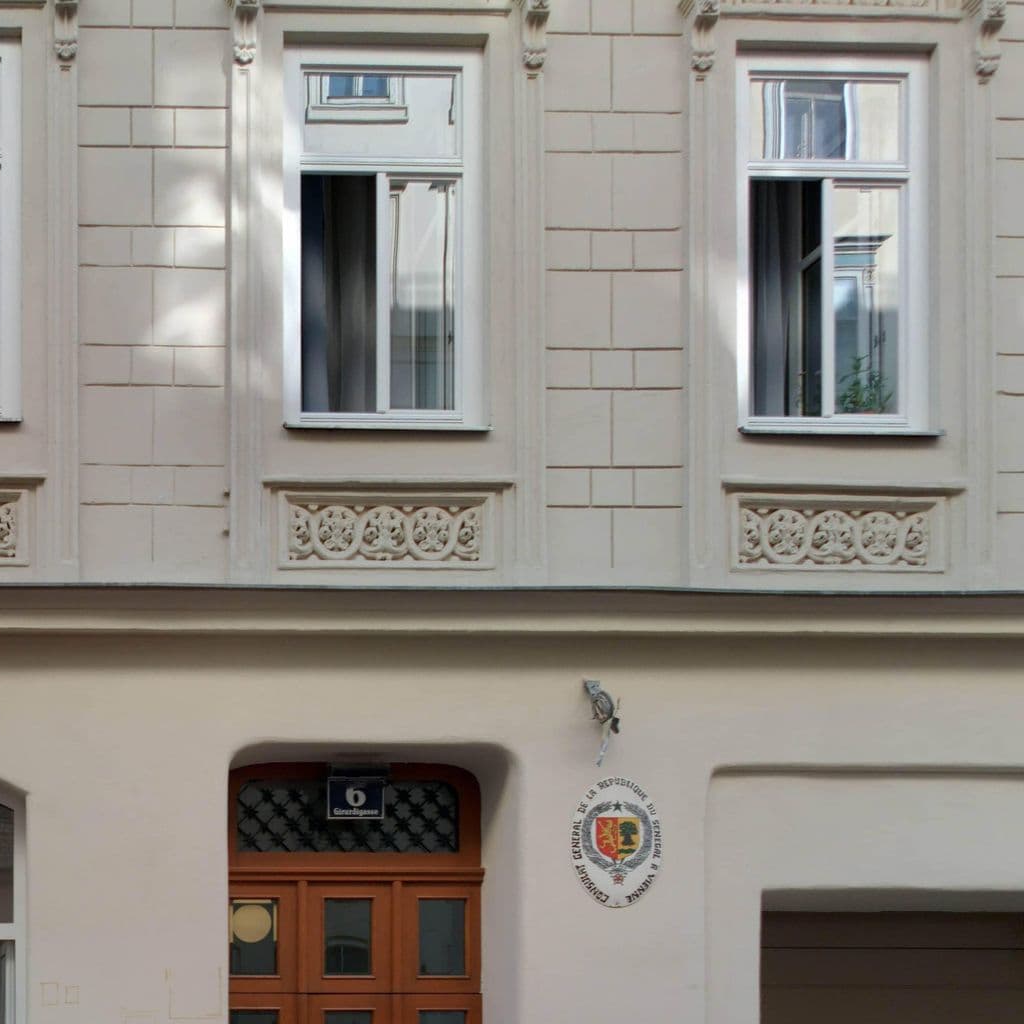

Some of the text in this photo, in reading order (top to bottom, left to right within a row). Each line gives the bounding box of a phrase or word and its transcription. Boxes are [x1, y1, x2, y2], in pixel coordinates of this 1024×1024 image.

[346, 784, 367, 807] 6
[586, 789, 597, 800] LA
[577, 802, 588, 814] DE
[646, 803, 657, 815] DU
[571, 820, 582, 860] GENERAL
[576, 865, 610, 904] CONSULAT
[626, 874, 656, 903] VIENNE
